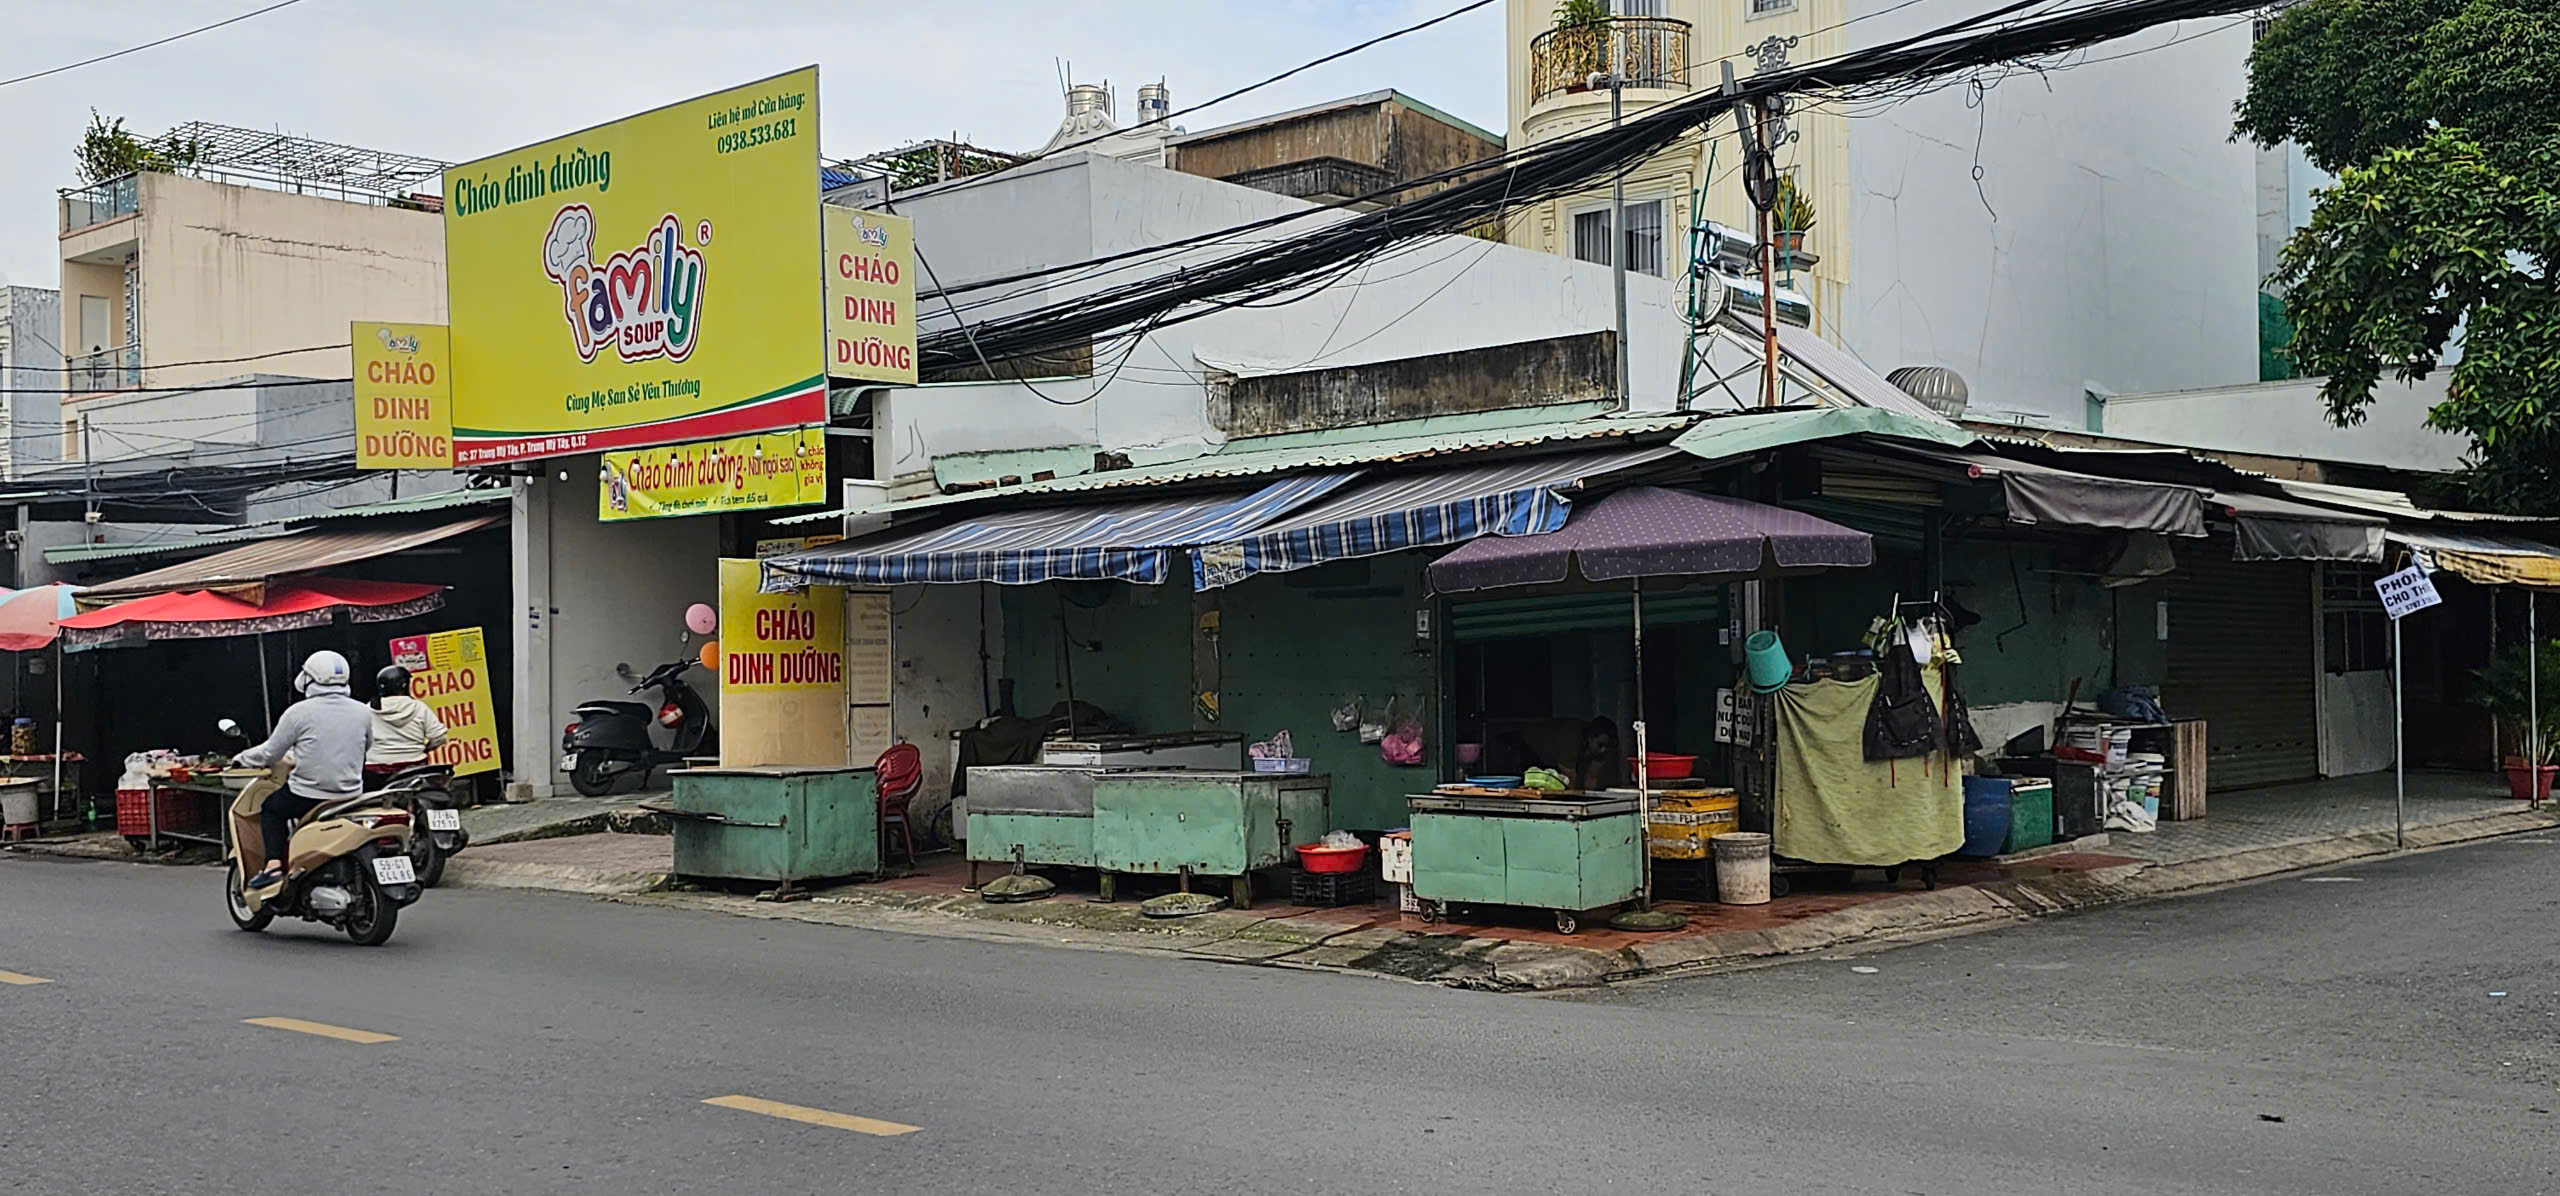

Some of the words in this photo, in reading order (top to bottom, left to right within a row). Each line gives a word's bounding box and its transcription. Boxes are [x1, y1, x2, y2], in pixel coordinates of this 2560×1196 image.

[708, 112, 727, 129] Liên
[729, 106, 740, 126] hệ
[758, 96, 776, 115] Cửa
[717, 118, 796, 154] 0938.533.681
[455, 172, 500, 217] Cháo
[504, 160, 545, 205] dinh
[550, 146, 610, 192] dưỡng
[839, 252, 899, 286] CHÁO
[844, 295, 896, 326] DINH
[624, 321, 664, 346] SOUP
[367, 355, 436, 385] CHÁO
[837, 336, 911, 371] DƯỠNG
[373, 397, 430, 421] DINH
[566, 393, 590, 414] Cùng
[592, 390, 606, 411] Mẹ
[608, 388, 626, 406] San
[642, 381, 660, 400] Yêu
[662, 378, 700, 399] Thương
[365, 429, 447, 459] DƯỠNG
[628, 454, 660, 492] Cháo
[664, 447, 694, 489] dinh
[698, 447, 744, 490] dưỡng
[780, 457, 794, 473] sao
[2385, 590, 2410, 607] CHO
[756, 602, 815, 641] CHÁO
[729, 652, 774, 685] DINH
[780, 646, 841, 684] DƯỠNG
[437, 701, 476, 729] INH
